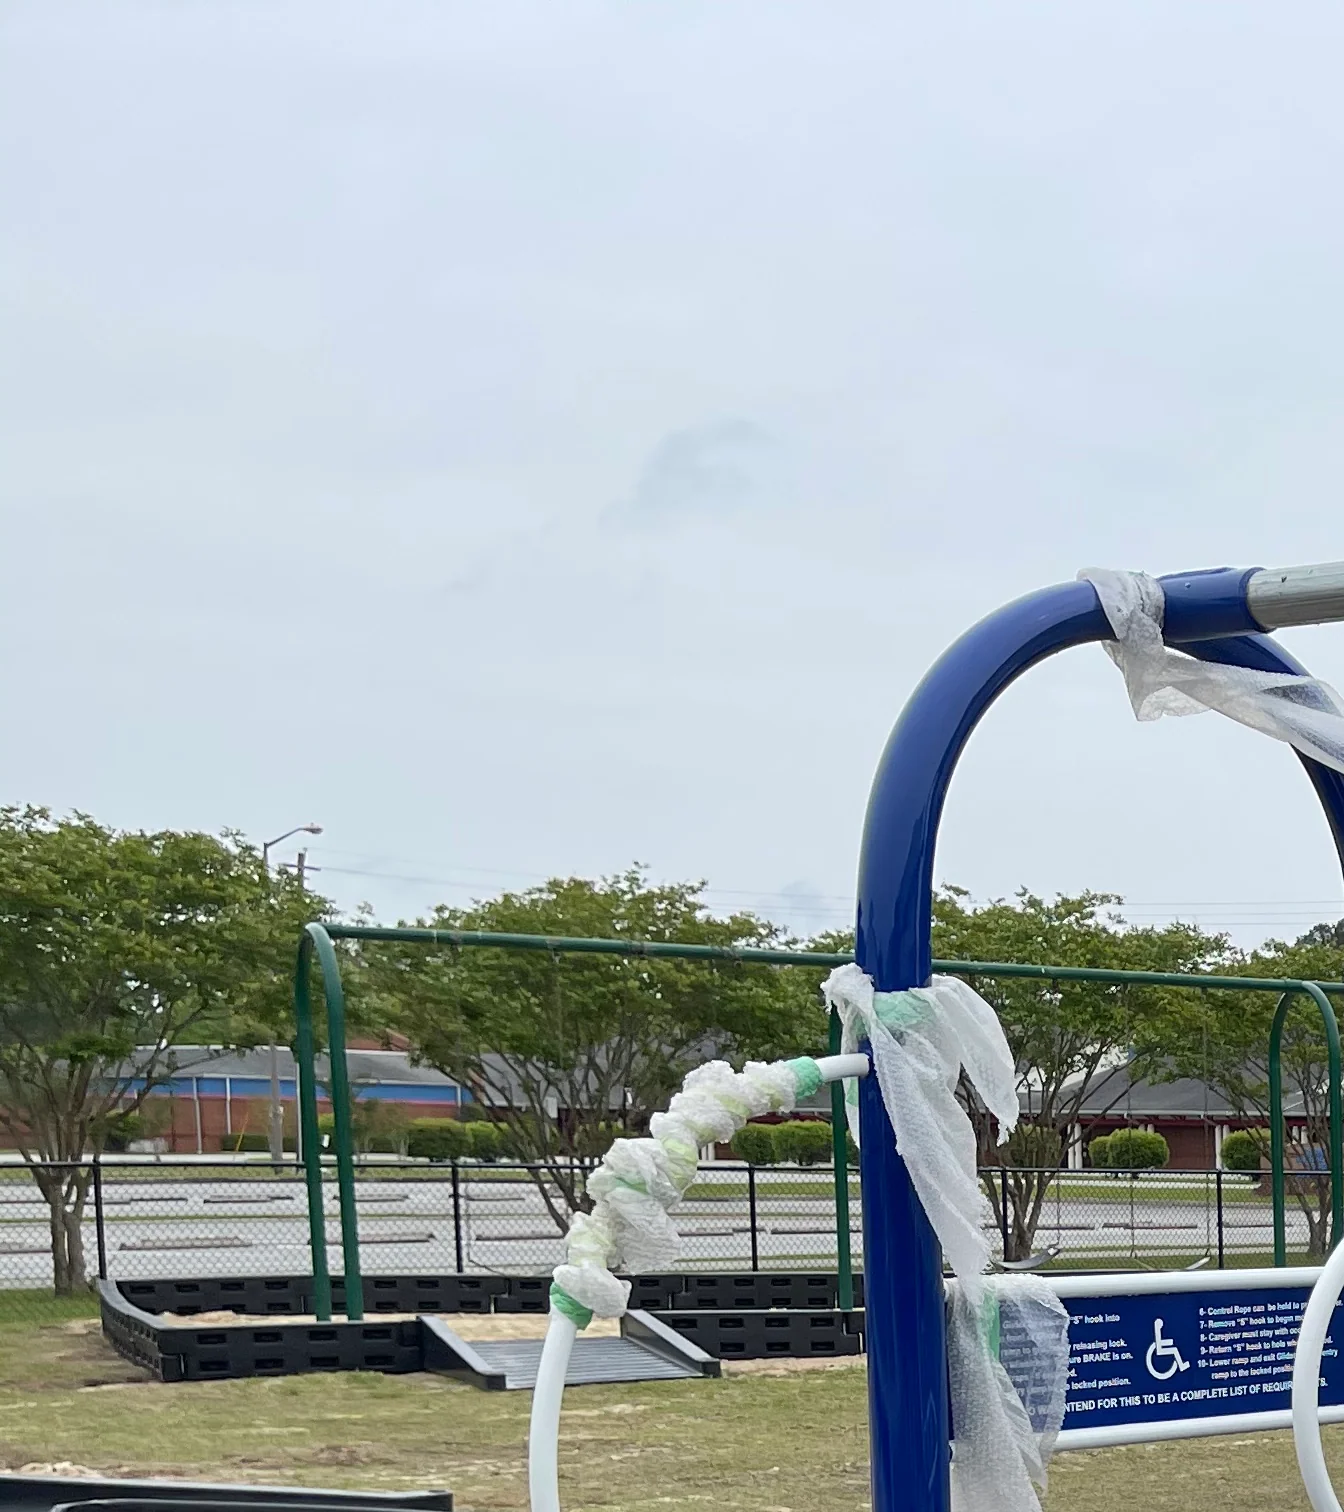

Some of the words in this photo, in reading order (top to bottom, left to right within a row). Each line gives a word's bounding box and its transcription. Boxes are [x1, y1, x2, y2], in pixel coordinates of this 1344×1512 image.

[1207, 1306, 1233, 1316] Control
[1082, 1352, 1111, 1363] BRAKE
[1071, 1379, 1097, 1390] locked
[1064, 1401, 1096, 1412] NTEND
[1097, 1398, 1118, 1409] FOR
[1119, 1396, 1141, 1407] THIS
[1142, 1394, 1156, 1404] TO
[1157, 1393, 1171, 1403] BE
[1171, 1392, 1180, 1402] A
[1180, 1387, 1229, 1401] COMPLETE
[1230, 1385, 1249, 1396] LIST
[1249, 1384, 1261, 1394] OF
